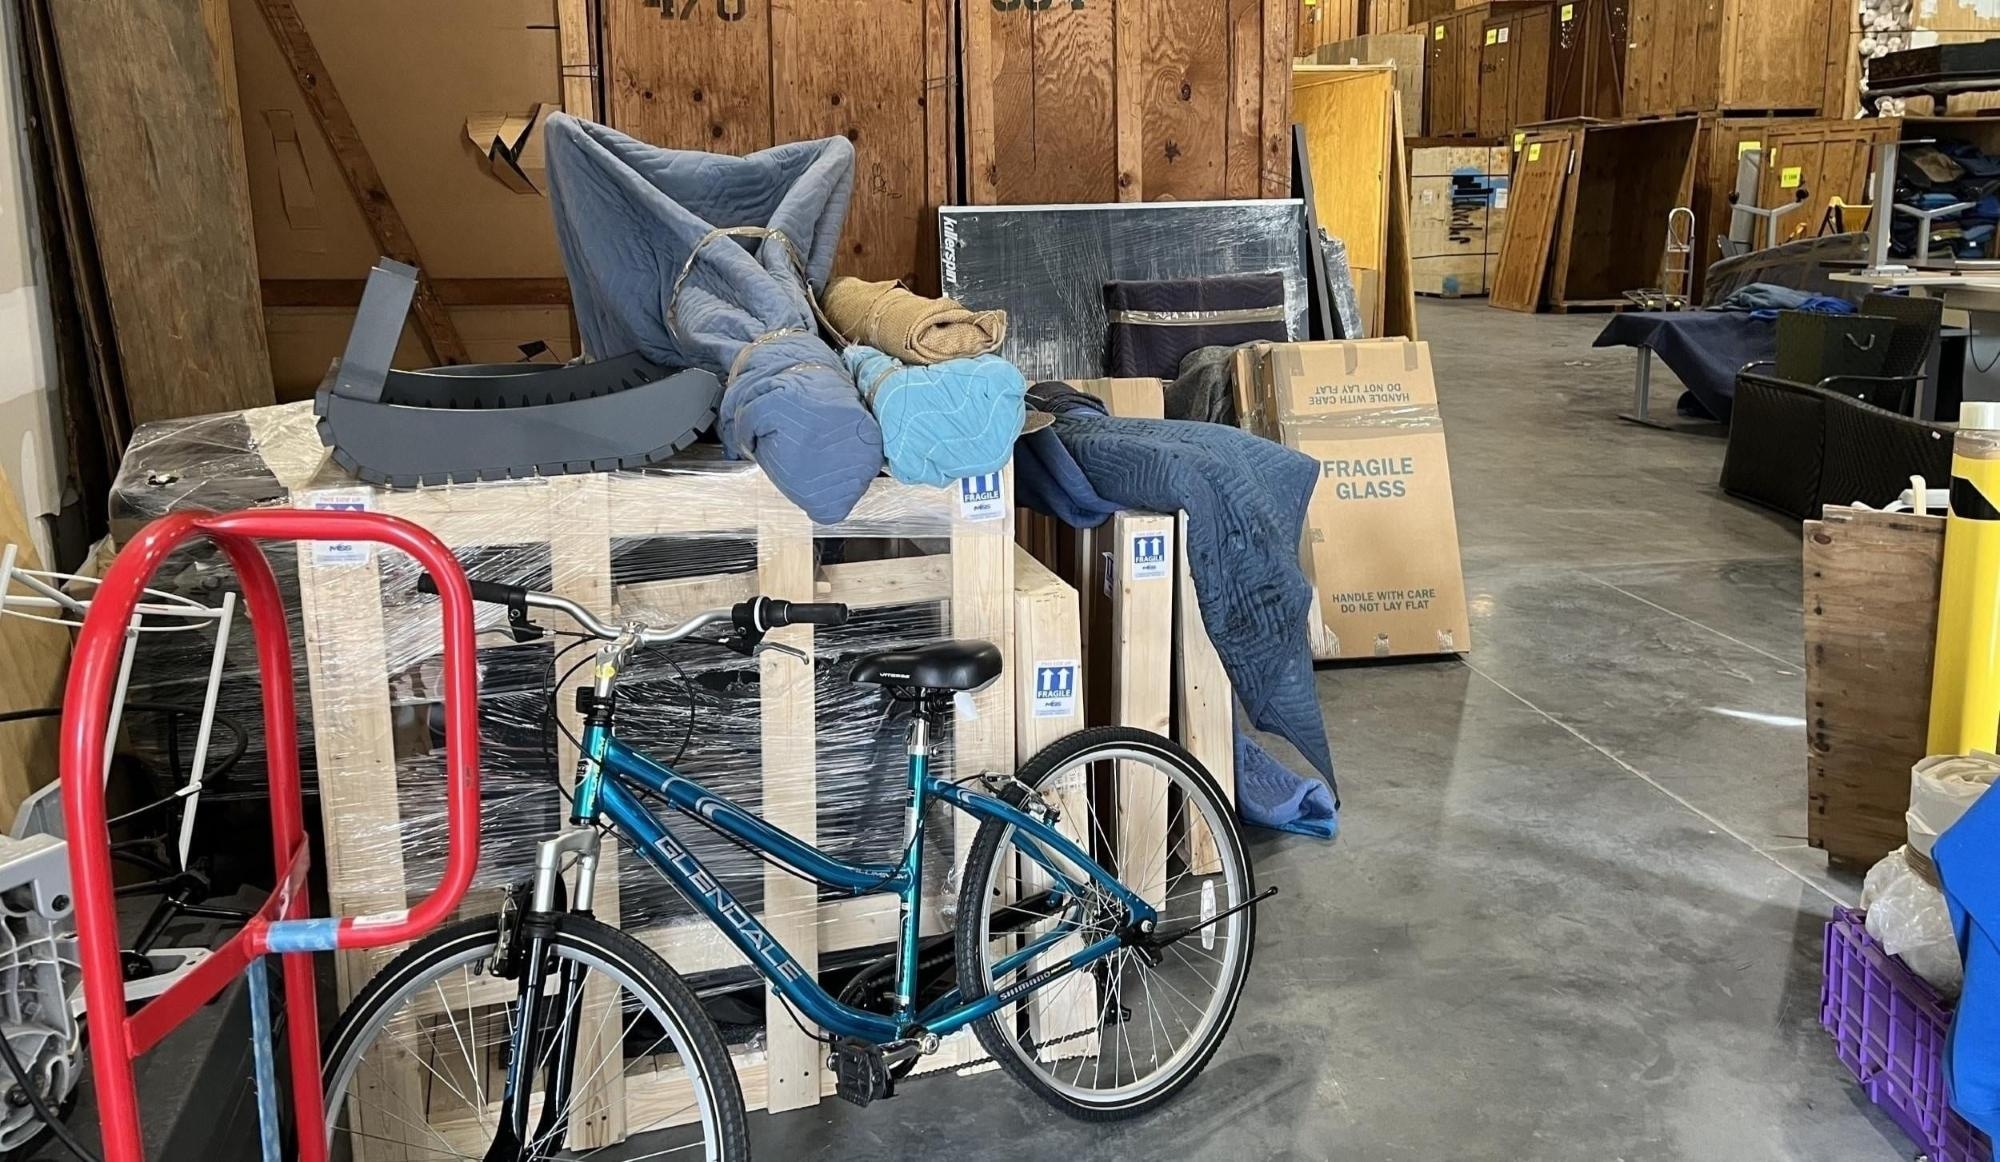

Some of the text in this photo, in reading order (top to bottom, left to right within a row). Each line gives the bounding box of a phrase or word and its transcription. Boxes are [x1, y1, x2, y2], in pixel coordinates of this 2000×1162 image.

[943, 216, 958, 284] killerspin
[1315, 383, 1402, 395] DO NOT LAY FLAT
[1308, 392, 1410, 406] HANDLE WITH CARE
[1323, 457, 1414, 478] FRAGILE
[964, 490, 999, 502] FRAGILE
[1335, 480, 1406, 500] GLASS
[1135, 555, 1164, 563] FRAGILE
[1332, 588, 1436, 603] HANDLE WITH CARE
[1341, 600, 1429, 614] DO NOT LAY FLAT
[1037, 689, 1071, 698] FRAGILE
[655, 836, 802, 983] GLENDALE
[1000, 971, 1052, 1001] SHIMANO
